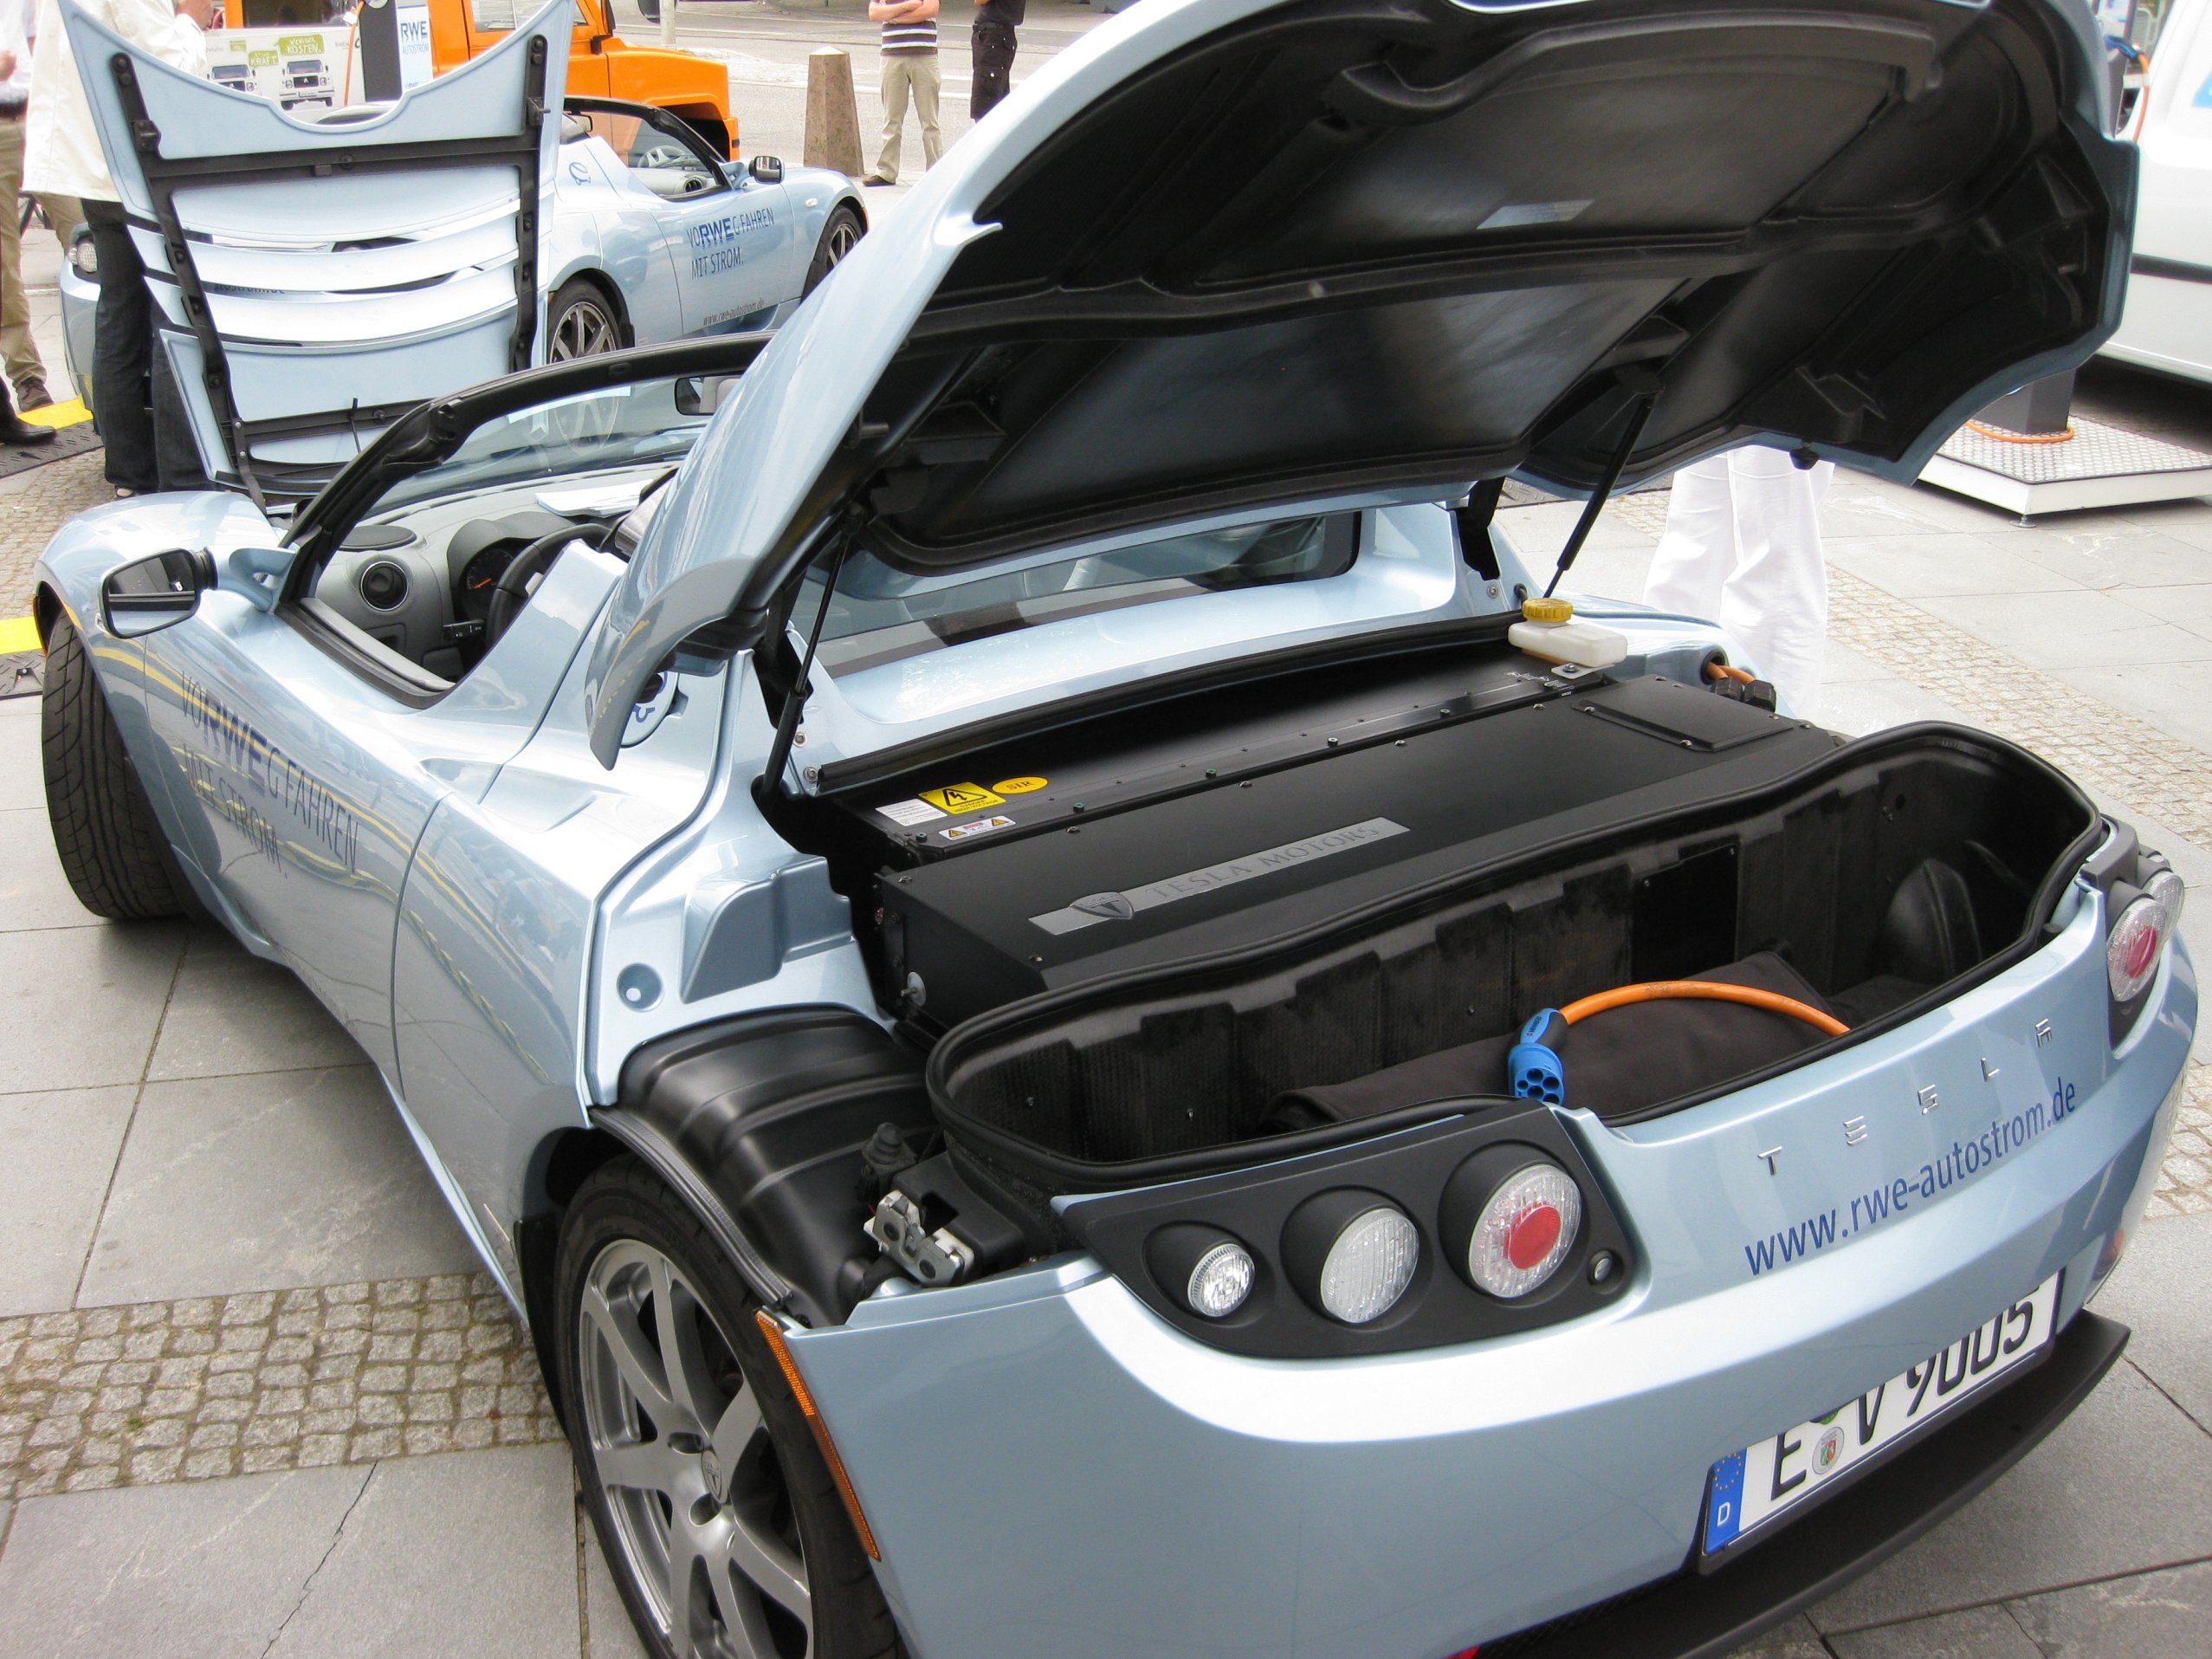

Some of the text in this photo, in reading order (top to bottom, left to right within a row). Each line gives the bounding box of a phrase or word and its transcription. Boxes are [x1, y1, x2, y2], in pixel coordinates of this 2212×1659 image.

[400, 21, 427, 41] RWE
[403, 42, 430, 55] AUTOSTROM
[740, 208, 774, 233] FAHREN
[692, 246, 744, 279] MIT STROM.
[1006, 780, 1036, 790] SIR
[184, 743, 288, 879] MIT STROM.
[285, 760, 359, 874] FAHREN
[1145, 826, 1379, 899] TESLA MOTORS
[1757, 1018, 2053, 1176] TESLA
[1744, 1076, 2076, 1275] www.rwe-autostrom.de
[1770, 1431, 1807, 1501] E
[1717, 1501, 1730, 1527] D
